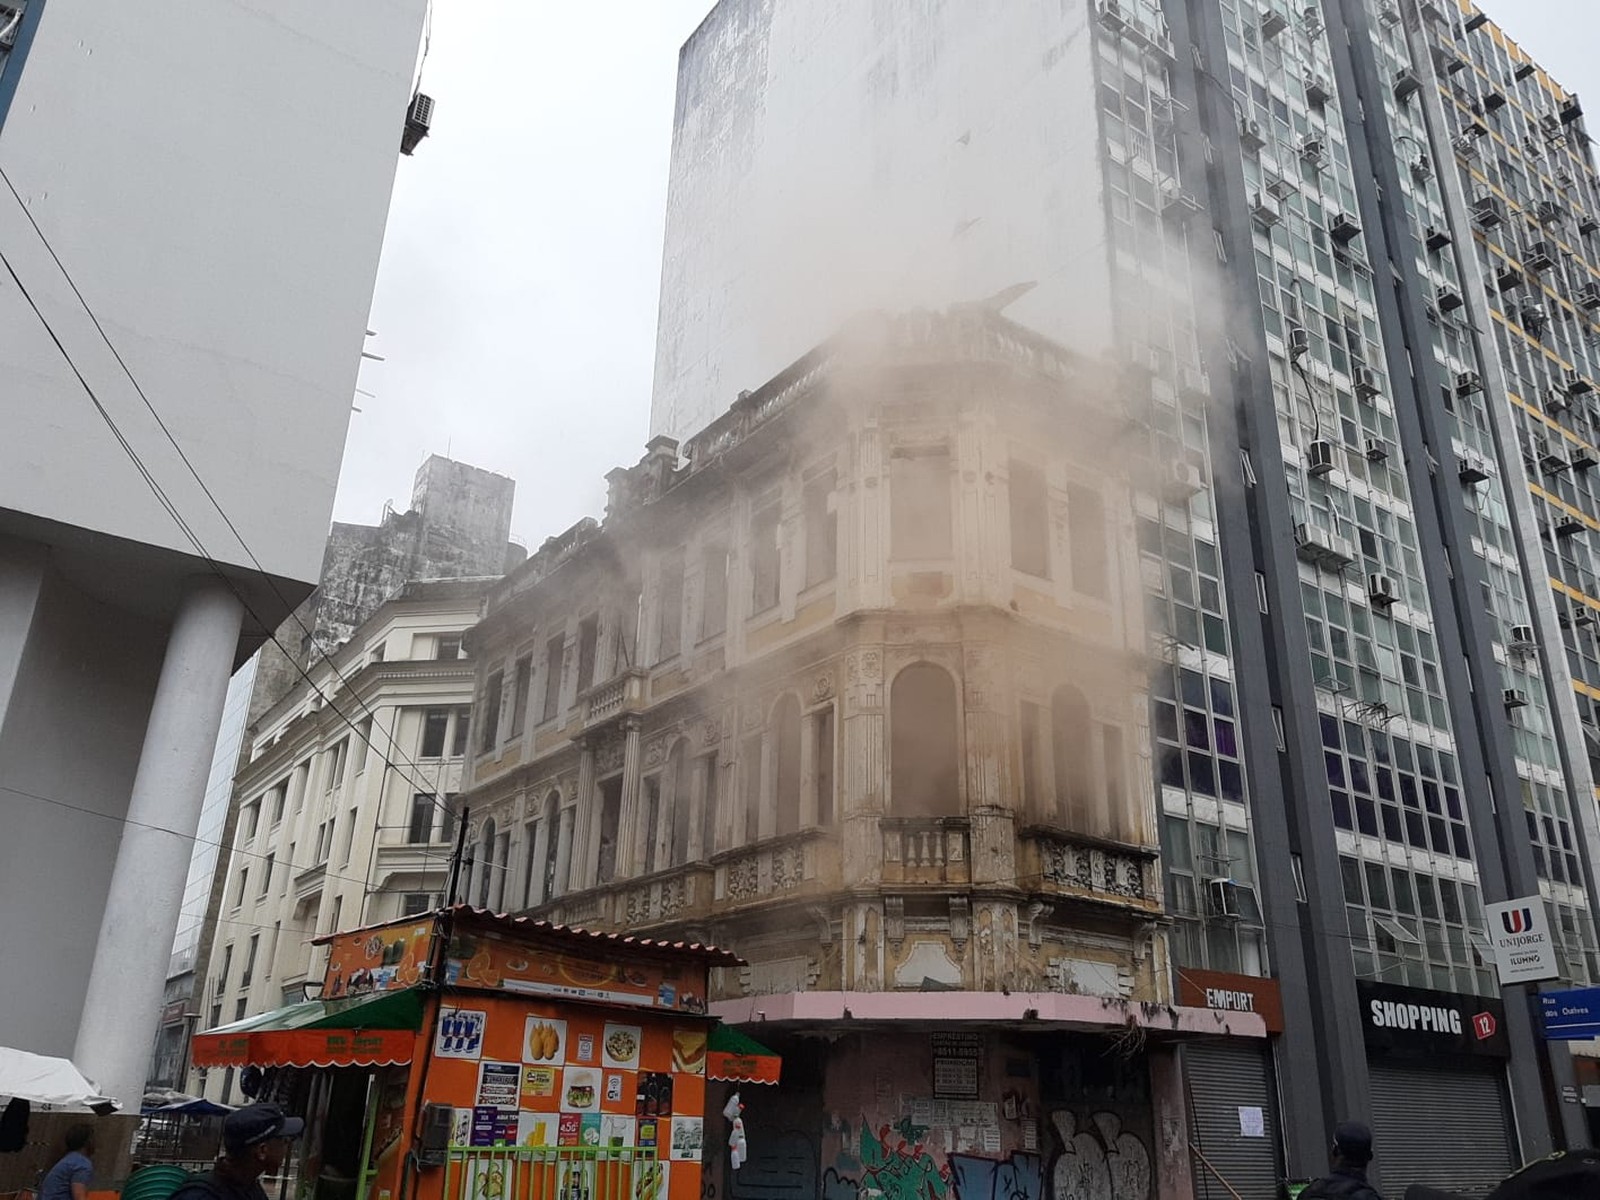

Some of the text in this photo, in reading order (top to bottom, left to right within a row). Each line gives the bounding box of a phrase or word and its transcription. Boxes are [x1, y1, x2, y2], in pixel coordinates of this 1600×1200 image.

[1499, 933, 1546, 949] UNIJORGE
[1206, 988, 1254, 1011] EMPORT
[1542, 997, 1556, 1005] Rua
[1371, 999, 1491, 1035] SHOPPING 12
